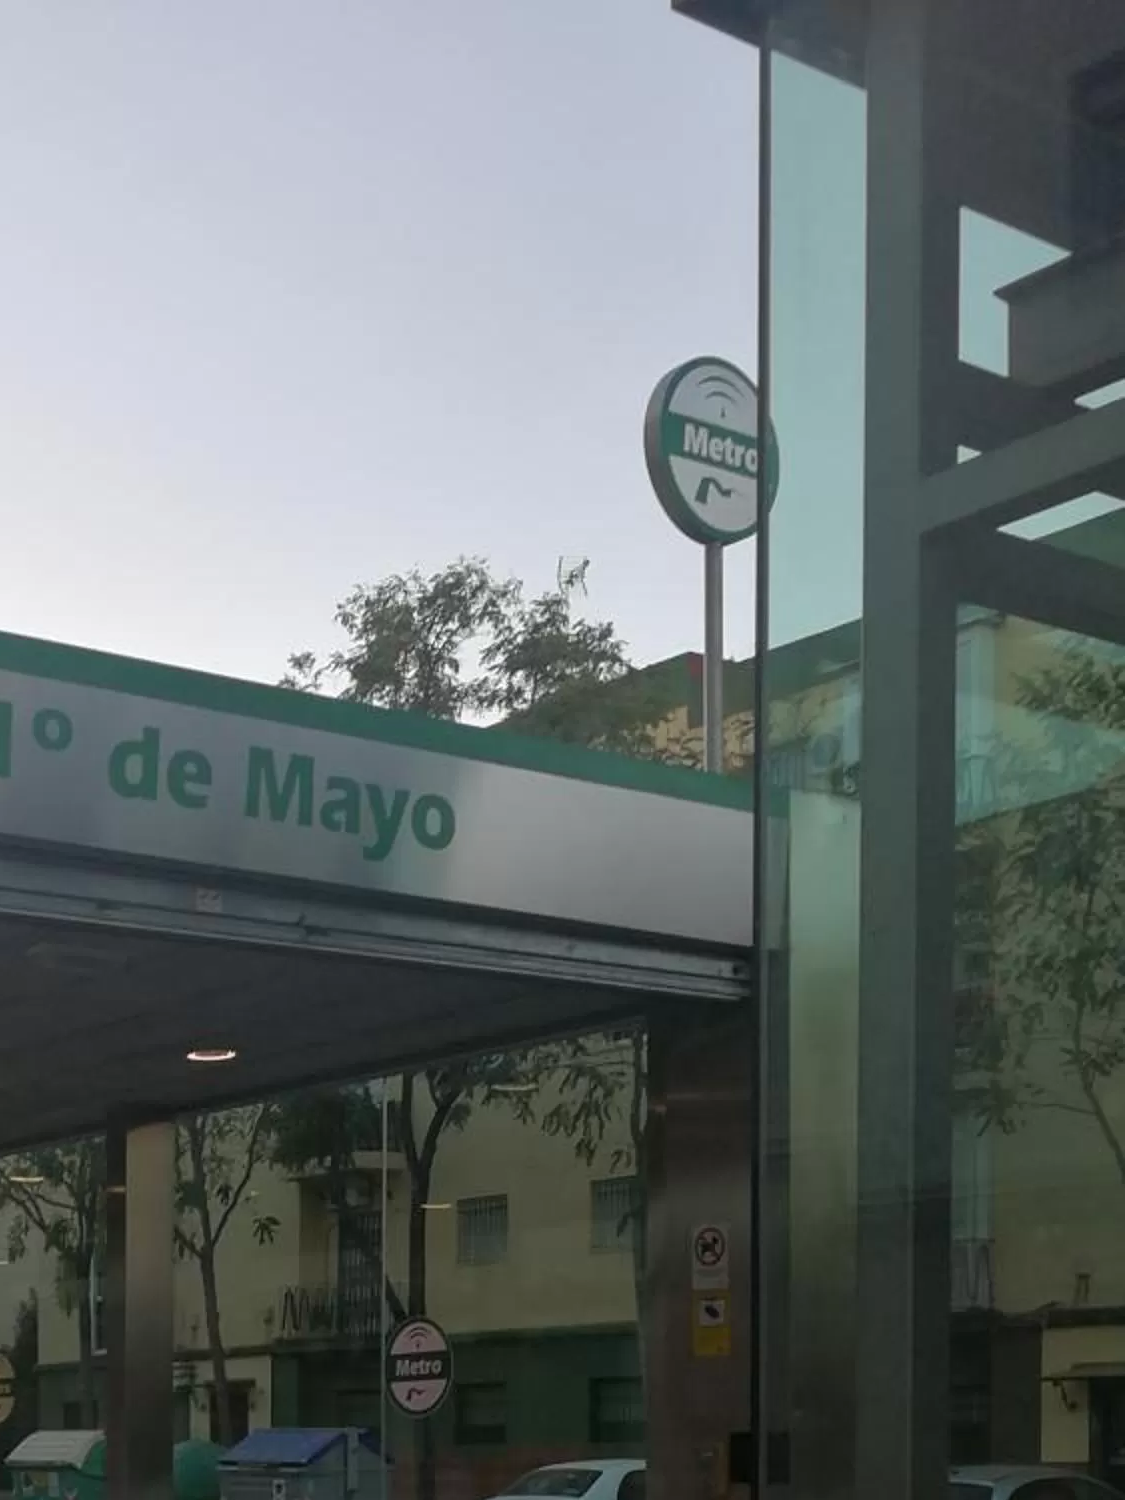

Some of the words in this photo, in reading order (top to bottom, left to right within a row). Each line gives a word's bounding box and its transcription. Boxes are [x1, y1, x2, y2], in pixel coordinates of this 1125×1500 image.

[683, 423, 759, 473] Metro
[107, 726, 213, 810] de
[244, 746, 457, 862] Mayo
[395, 1359, 443, 1377] Metro
